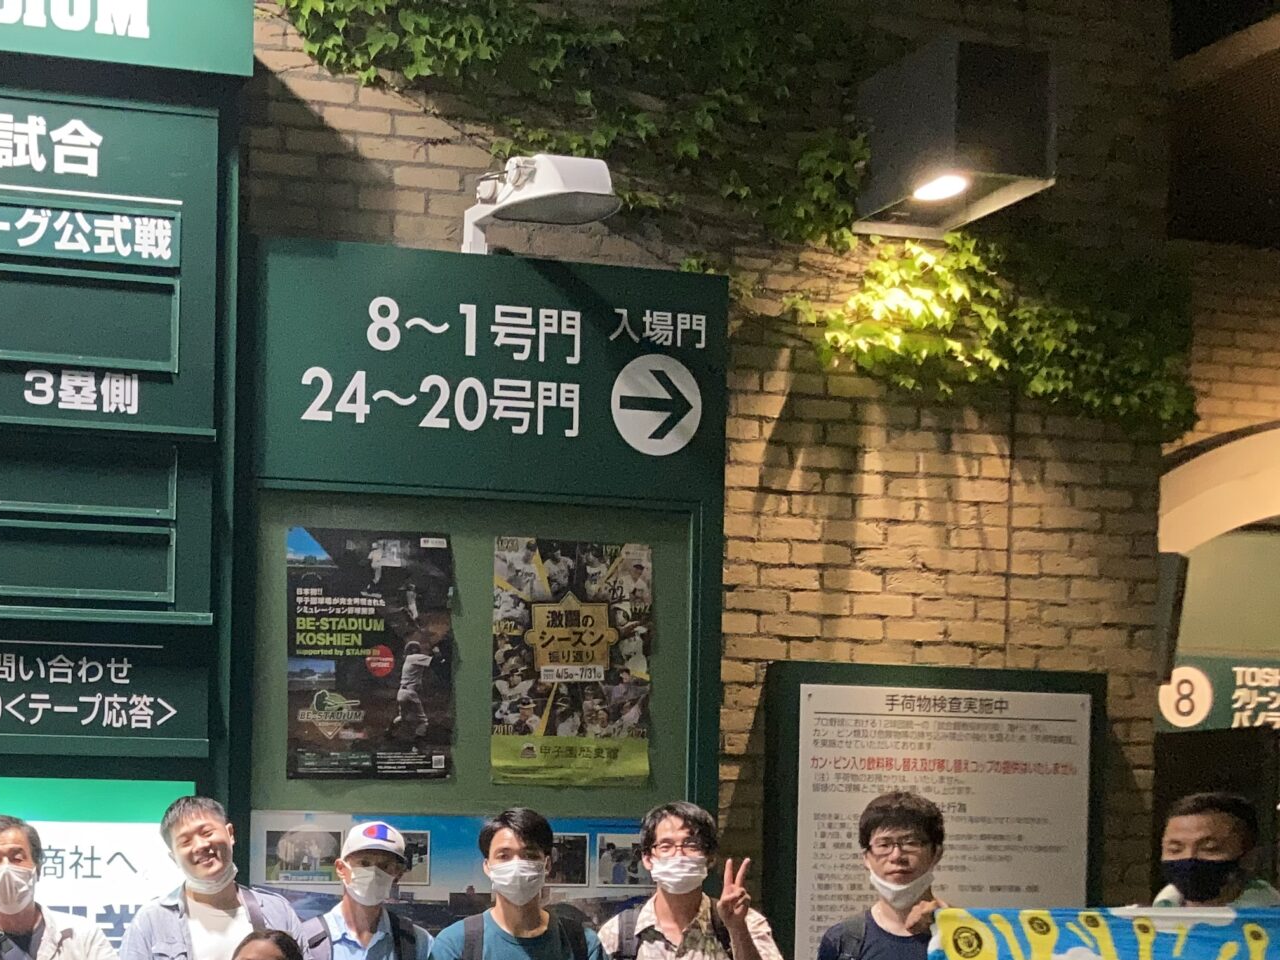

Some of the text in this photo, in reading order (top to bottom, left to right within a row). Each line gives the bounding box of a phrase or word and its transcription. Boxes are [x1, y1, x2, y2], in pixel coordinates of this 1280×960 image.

[609, 308, 707, 349] 入場門
[24, 370, 140, 415] 3塁側
[296, 617, 385, 632] BE-STADIUM
[296, 632, 363, 646] KOSHIEN
[539, 630, 604, 648] シーズン
[885, 694, 1009, 714] 手荷物検査実施中
